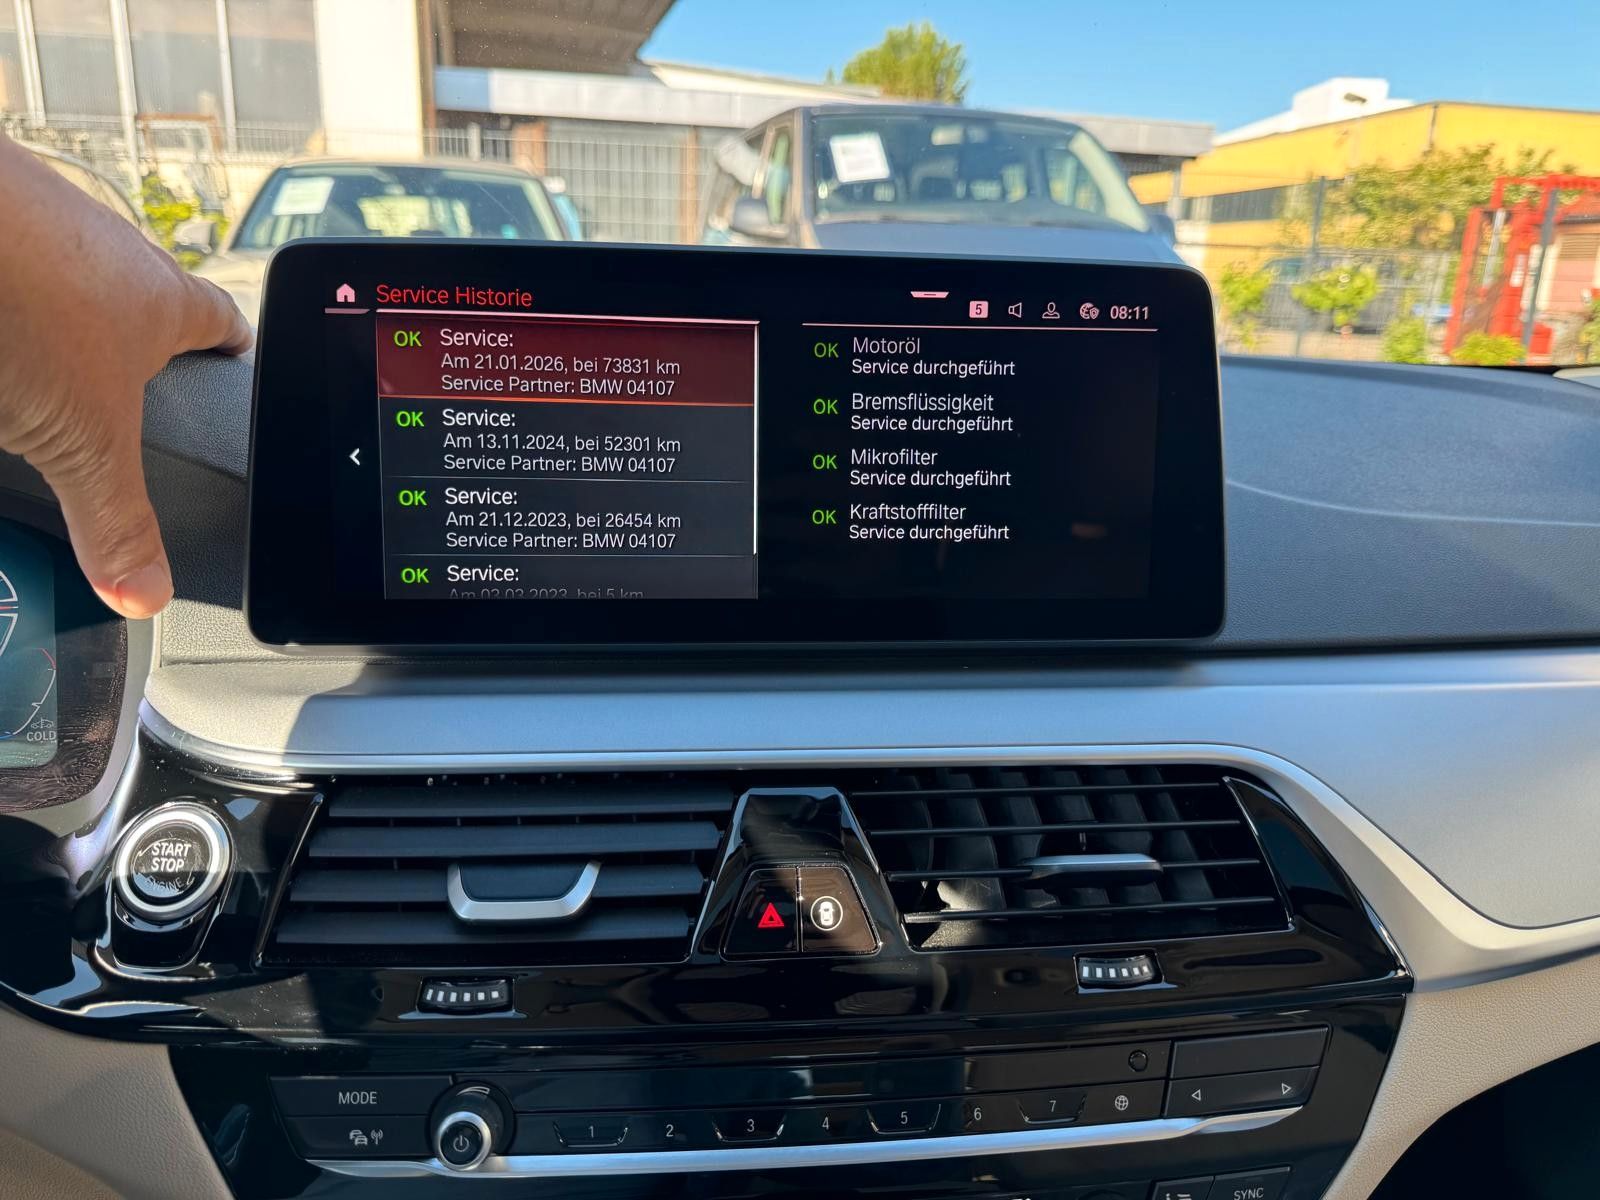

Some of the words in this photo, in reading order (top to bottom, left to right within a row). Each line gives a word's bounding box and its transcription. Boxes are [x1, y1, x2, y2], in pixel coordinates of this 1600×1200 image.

[376, 285, 448, 304] Service
[456, 287, 532, 306] Historie
[1110, 306, 1149, 320] 08:11
[394, 330, 422, 347] OK
[440, 329, 513, 347] Service:
[853, 337, 920, 355] Motoröl
[814, 343, 838, 357] OK
[441, 354, 469, 369] Am
[475, 355, 568, 374] 21.01.2026,
[574, 357, 598, 373] bei
[603, 358, 650, 374] 73831
[656, 359, 680, 374] km
[852, 360, 908, 375] Service
[913, 361, 1015, 378] durchgeführt
[441, 376, 503, 392] Service
[509, 377, 575, 393] Partner:
[580, 378, 622, 394] BMW
[627, 380, 675, 395] 04107
[813, 399, 838, 414] OK
[853, 393, 993, 414] Bremsflüssigkeit
[396, 411, 424, 427] OK
[442, 409, 516, 426] Service:
[851, 416, 907, 430] Service
[912, 417, 1013, 434] durchgeführt
[444, 434, 472, 449] Am
[477, 434, 570, 452] 13.11.2024,
[576, 435, 599, 451] bei
[604, 437, 651, 452] 52301
[657, 437, 681, 452] km
[444, 455, 505, 470] Service
[511, 456, 576, 471] Partner:
[582, 457, 623, 472] BMW
[628, 458, 675, 473] 04107
[813, 455, 837, 469] OK
[851, 449, 937, 465] Mikrofilter
[850, 471, 906, 486] Service
[910, 471, 1011, 489] durchgeführt
[399, 489, 427, 506] OK
[445, 488, 517, 505] Service:
[812, 510, 836, 524] OK
[850, 504, 966, 520] Kraftstofffilter
[446, 512, 474, 527] Am
[479, 512, 571, 530] 21.12.2023,
[577, 513, 600, 528] bei
[605, 513, 652, 528] 26454
[658, 513, 681, 528] km
[446, 533, 507, 548] Service
[513, 534, 577, 548] Partner:
[583, 534, 624, 549] BMW
[629, 534, 676, 549] 04107
[849, 525, 904, 540] Service
[909, 525, 1009, 542] durchgeführt
[401, 567, 429, 583] OK
[447, 566, 519, 582] Service:
[450, 588, 476, 599] Am
[480, 588, 568, 599] 03032023
[578, 588, 601, 599] bei
[621, 588, 643, 599] km
[26, 731, 57, 741] COLD
[151, 842, 191, 857] START
[151, 857, 184, 873] STOP
[338, 1091, 377, 1104] MODE
[973, 1107, 983, 1120] 6
[1048, 1101, 1057, 1112] 7
[746, 1119, 756, 1132] 3
[821, 1117, 830, 1130] 4
[899, 1111, 909, 1124] 5
[588, 1126, 595, 1137] 1
[665, 1124, 675, 1137] 2
[1233, 1188, 1264, 1200] SYNC
